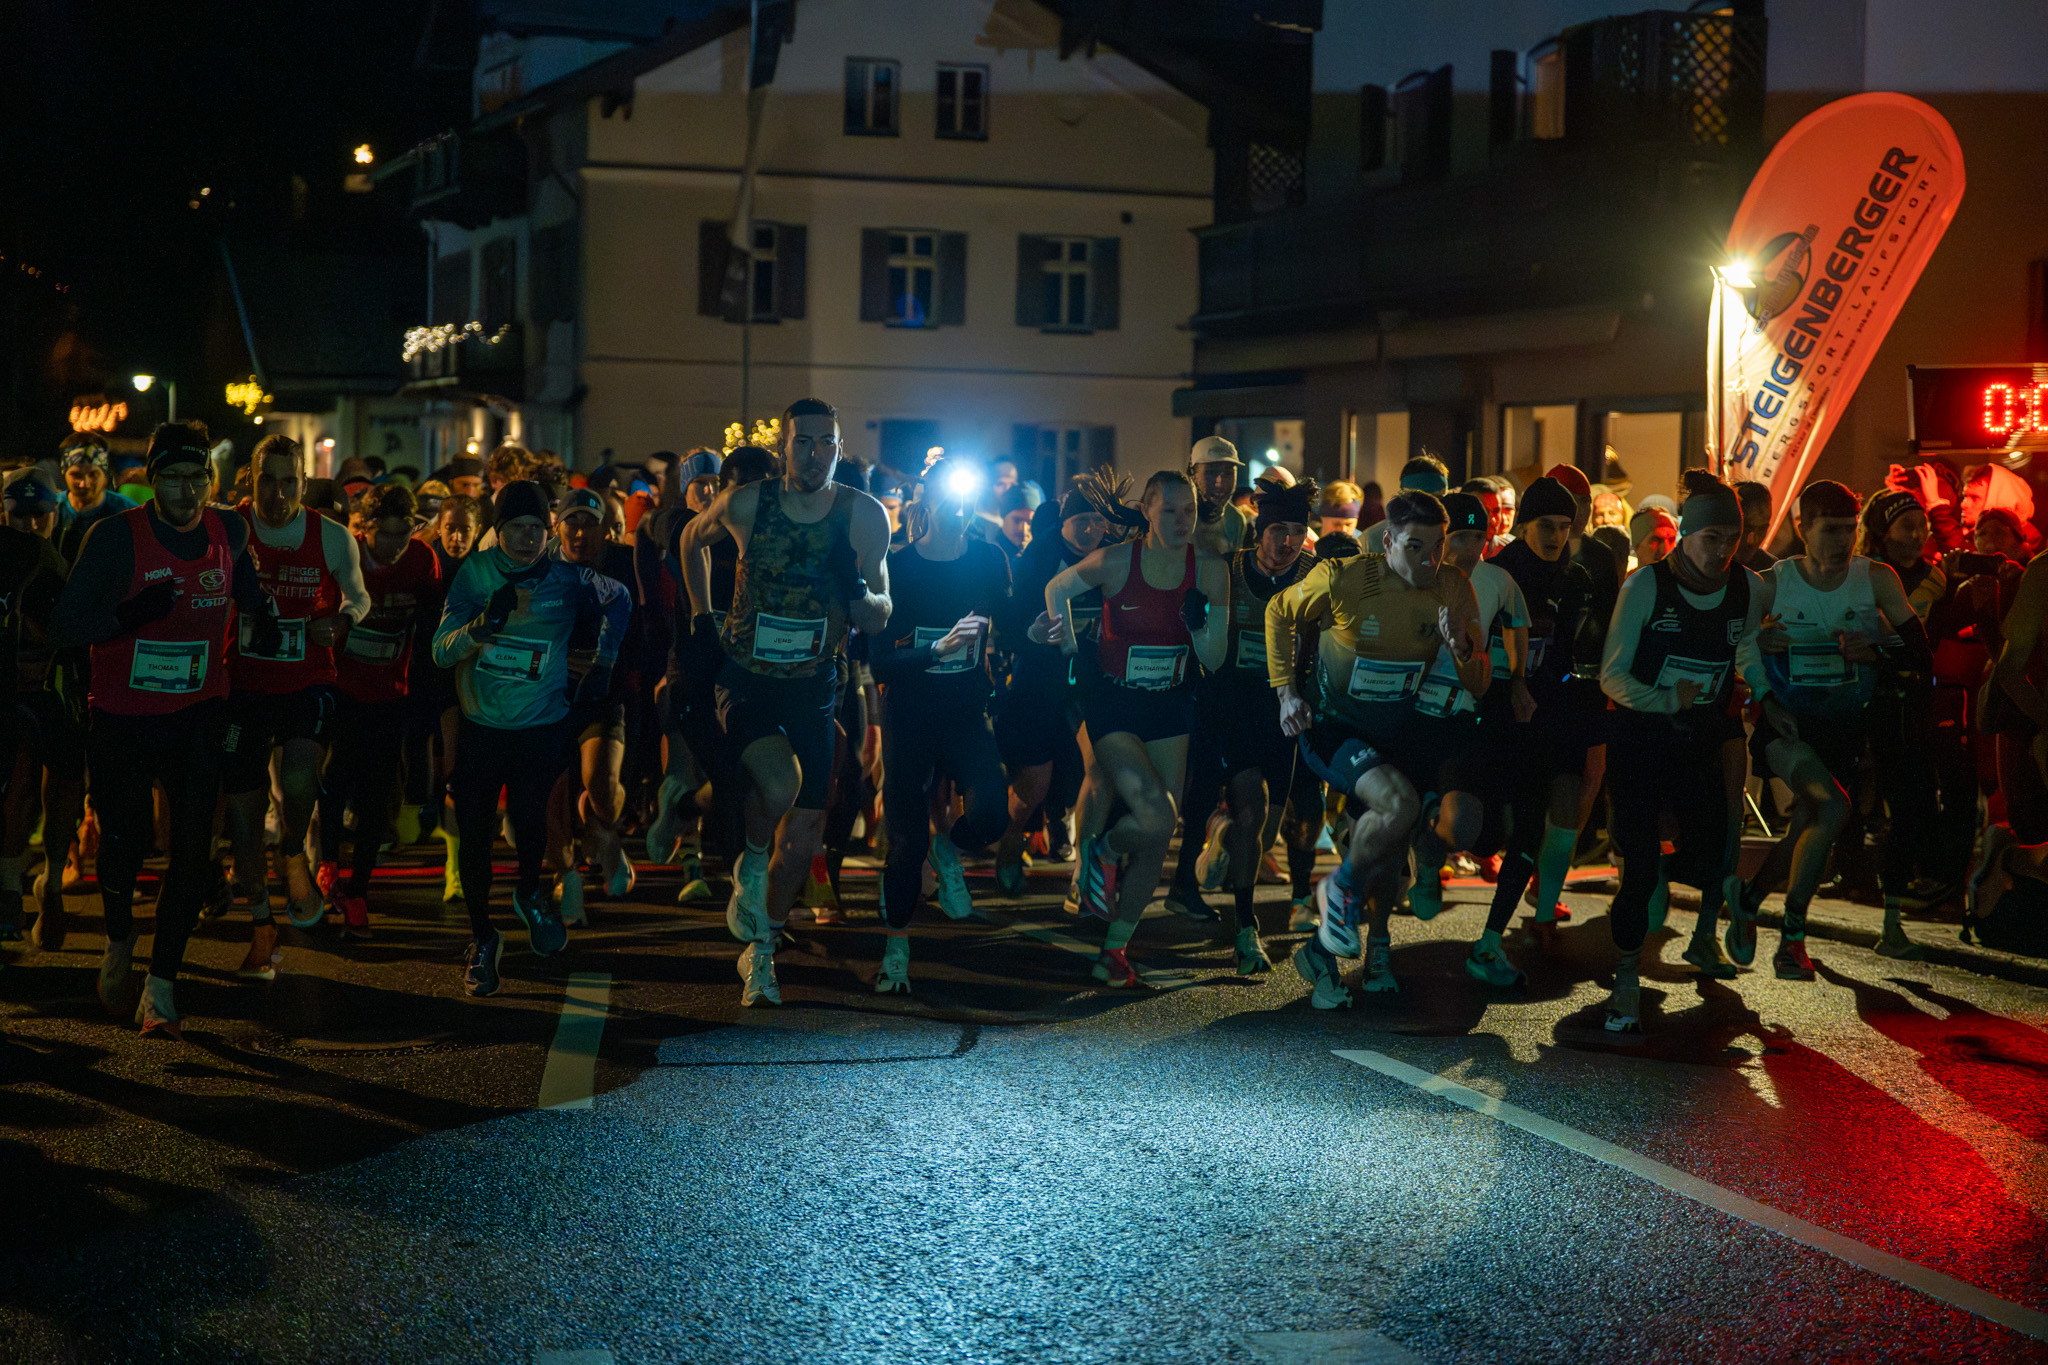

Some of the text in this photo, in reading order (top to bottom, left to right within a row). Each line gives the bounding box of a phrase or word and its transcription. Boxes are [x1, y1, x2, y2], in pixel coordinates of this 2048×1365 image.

[1732, 147, 1919, 469] STEIGENBERGER
[1762, 331, 1844, 478] BERGSPORT
[1851, 164, 1939, 309] LAUFSPORT
[145, 567, 172, 581] HOKA
[148, 663, 180, 671] THOMAS
